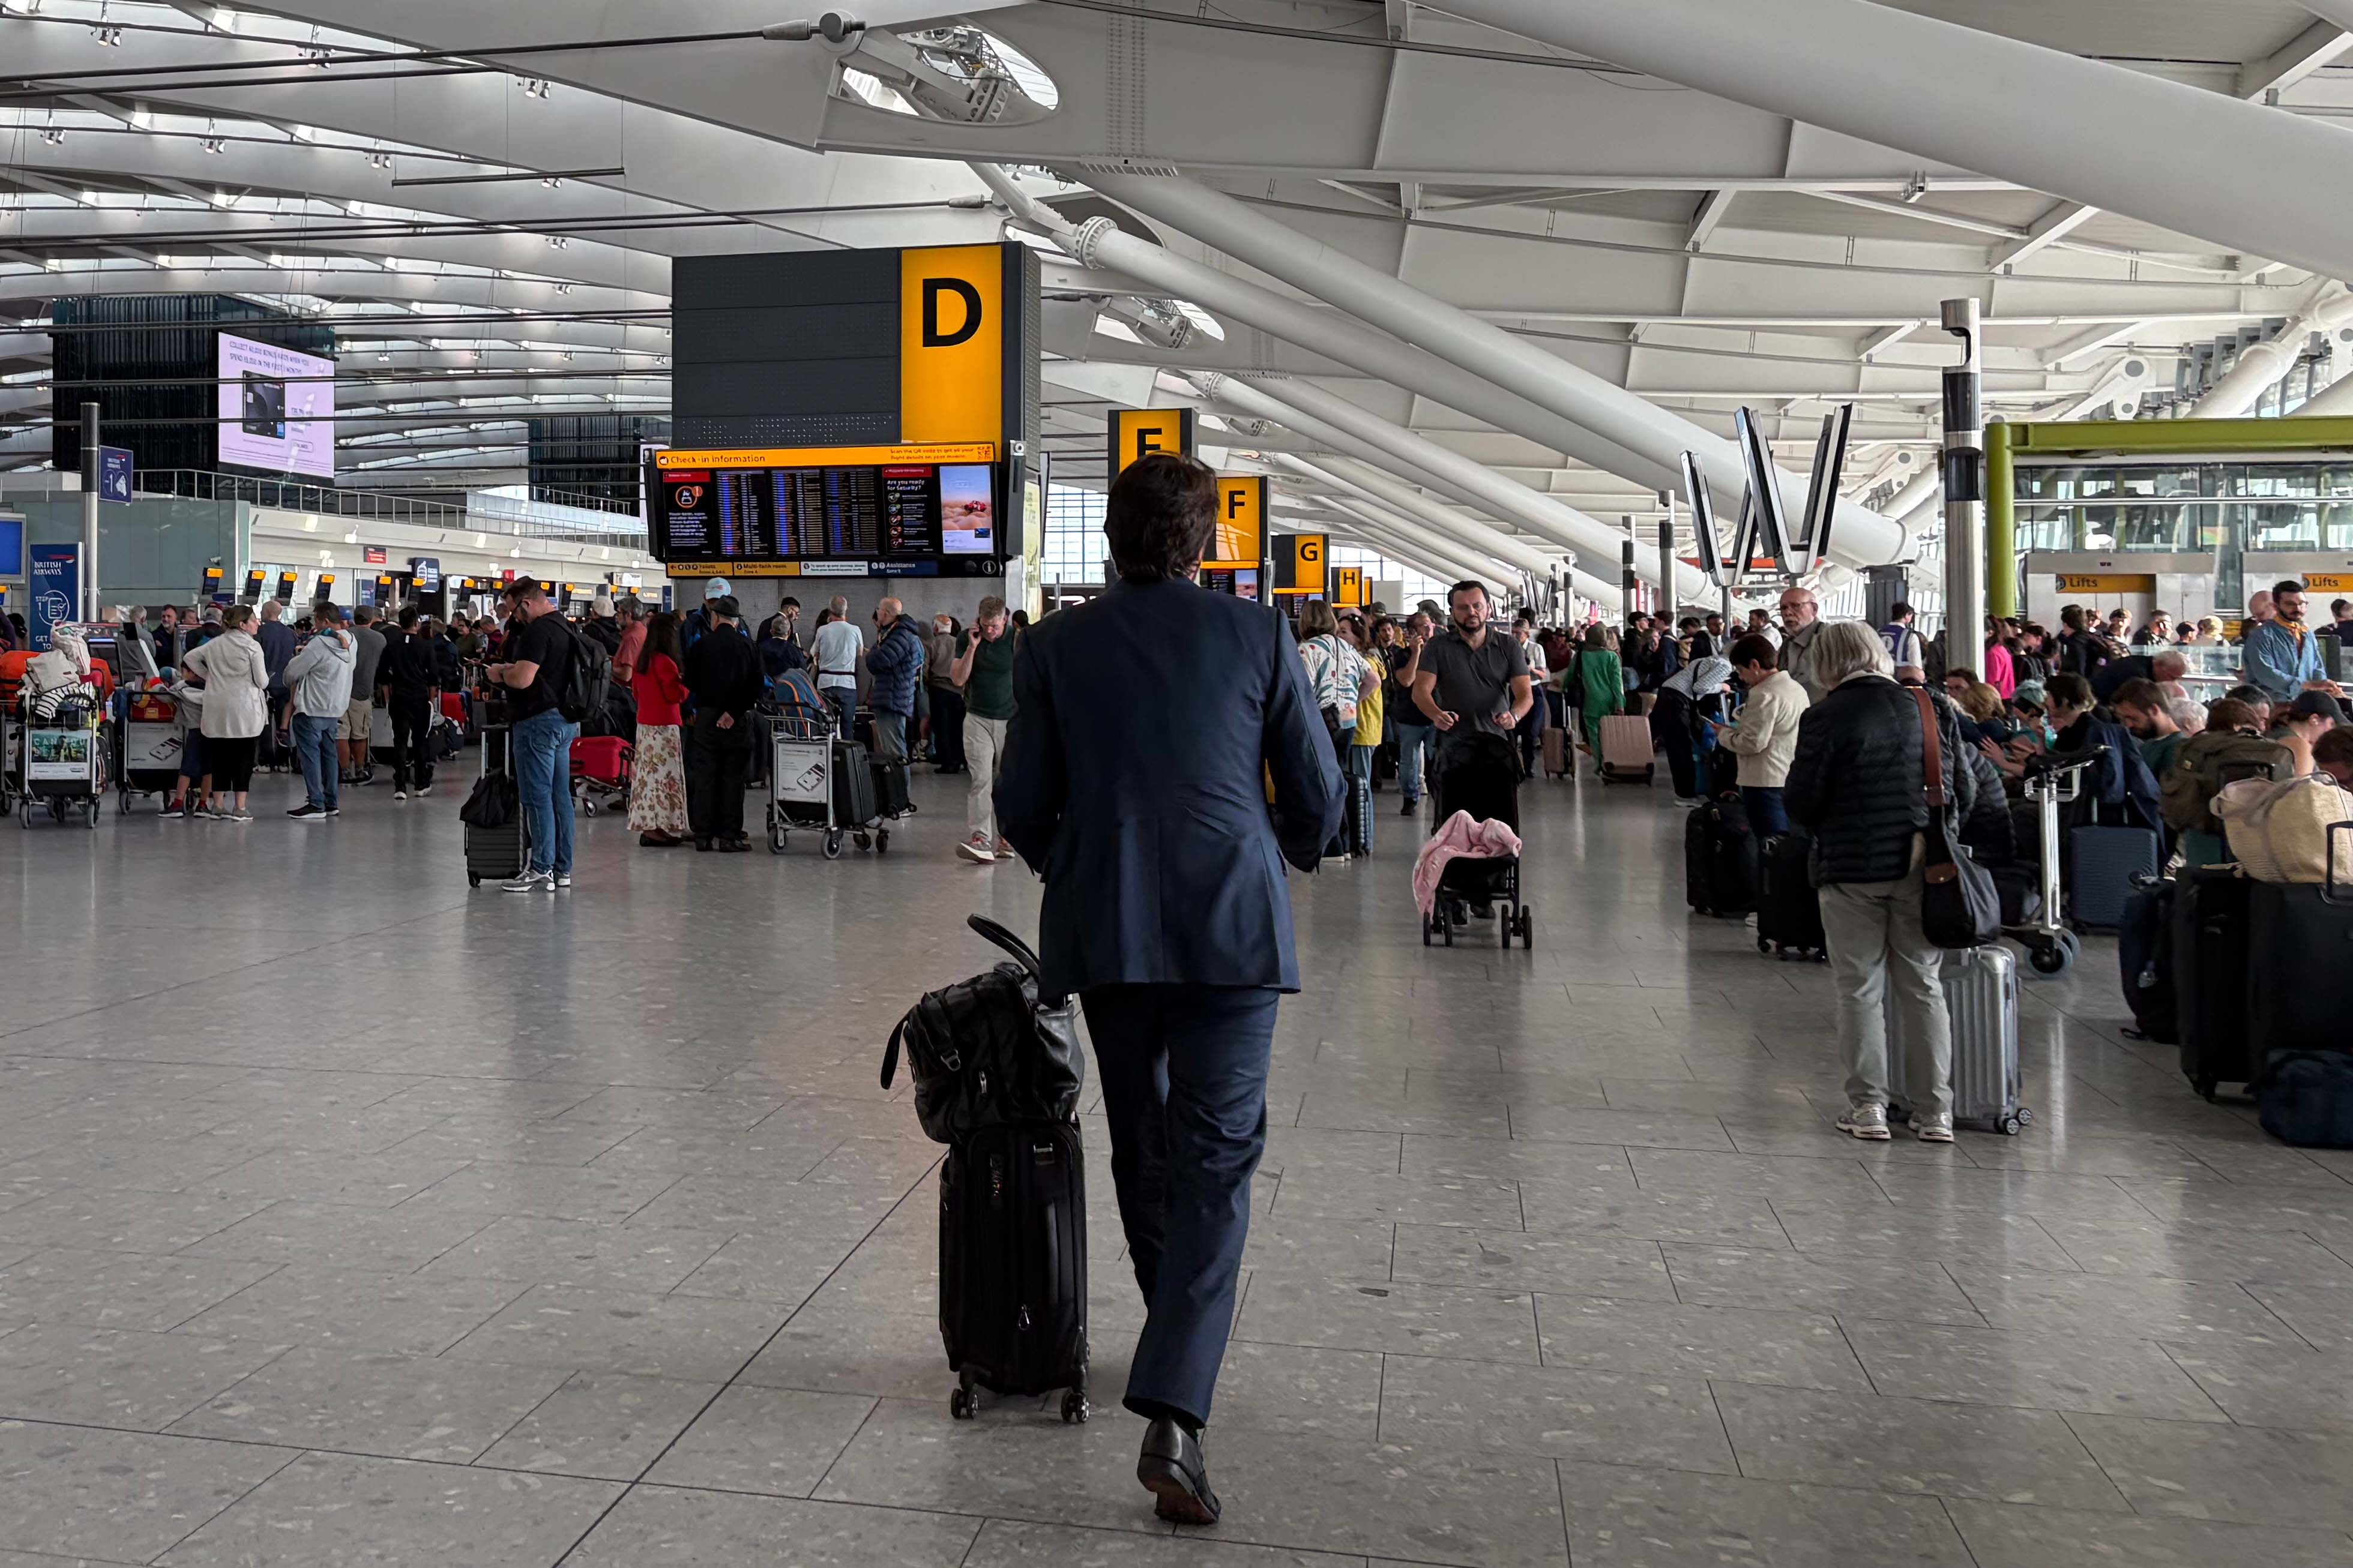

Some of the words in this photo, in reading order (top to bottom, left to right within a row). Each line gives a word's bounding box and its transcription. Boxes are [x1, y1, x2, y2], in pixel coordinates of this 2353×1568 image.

[923, 278, 982, 347] D
[1137, 428, 1162, 460] E
[712, 454, 765, 463] information
[1228, 490, 1246, 518] F
[1300, 542, 1318, 561] G
[1343, 572, 1355, 585] H
[2070, 577, 2098, 587] Lifts
[2313, 577, 2339, 586] Lifts
